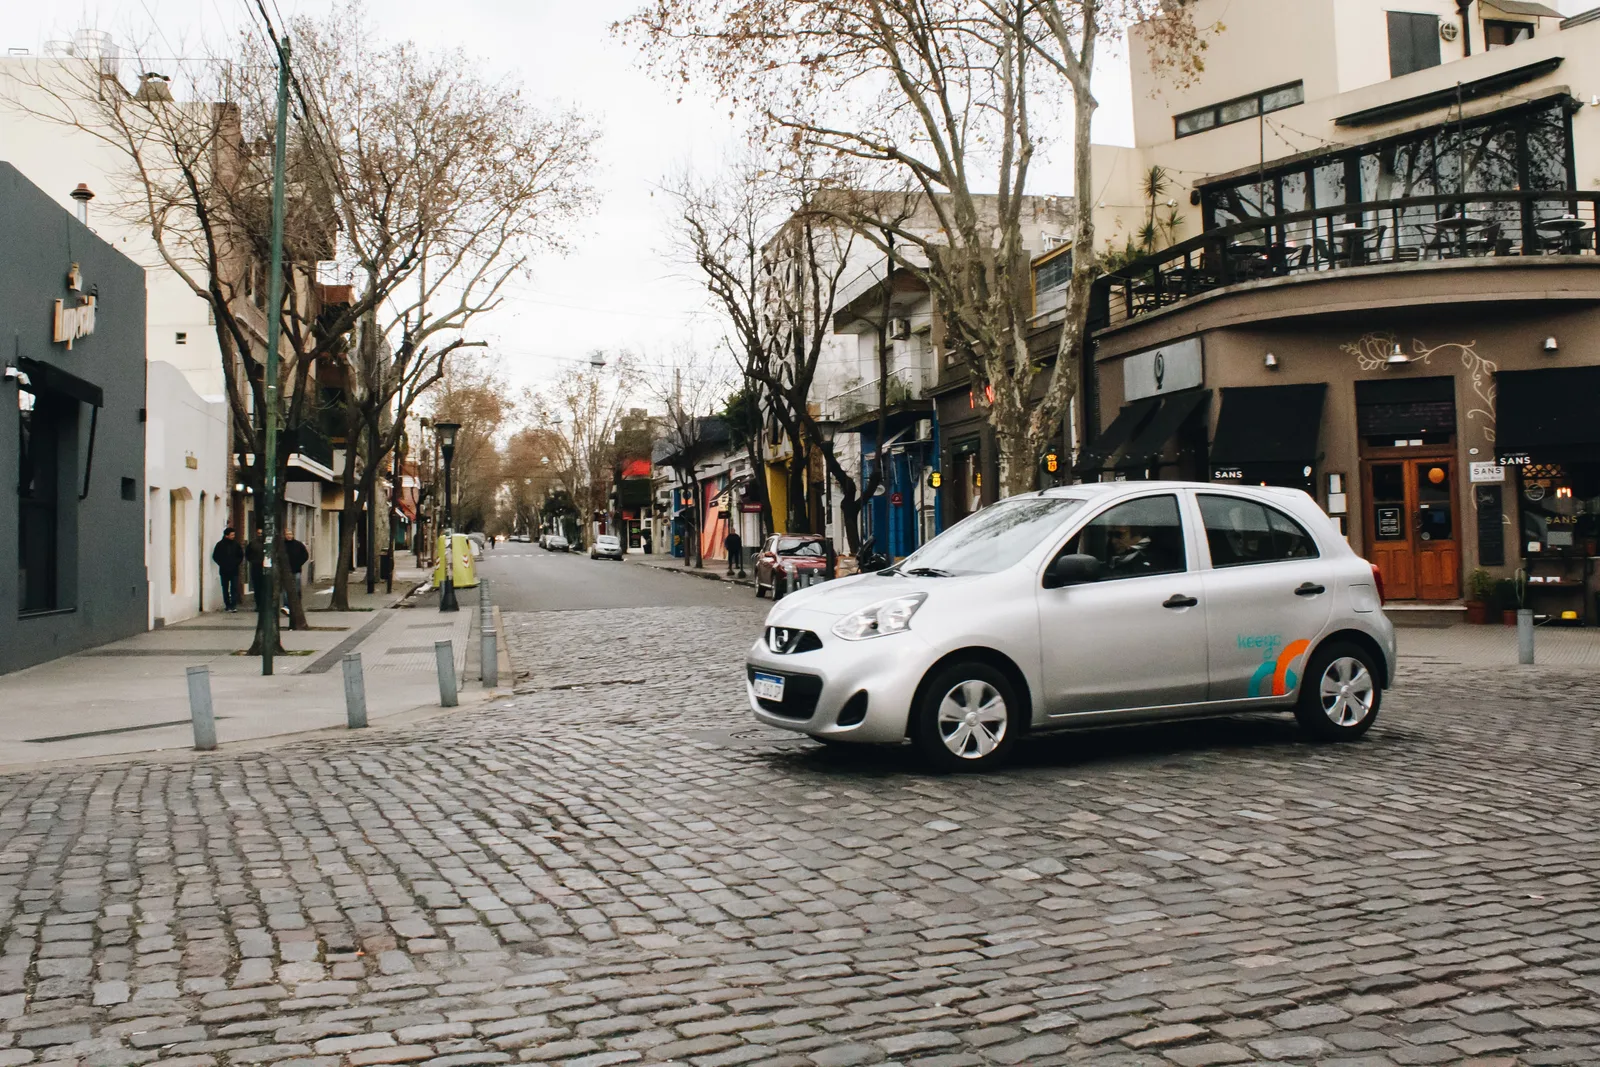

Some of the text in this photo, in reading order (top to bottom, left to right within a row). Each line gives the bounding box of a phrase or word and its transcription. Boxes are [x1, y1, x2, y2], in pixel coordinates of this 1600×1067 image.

[1500, 456, 1531, 465] SANS
[1214, 471, 1243, 479] SANS
[1473, 467, 1502, 475] SANS
[1545, 516, 1578, 525] SANS
